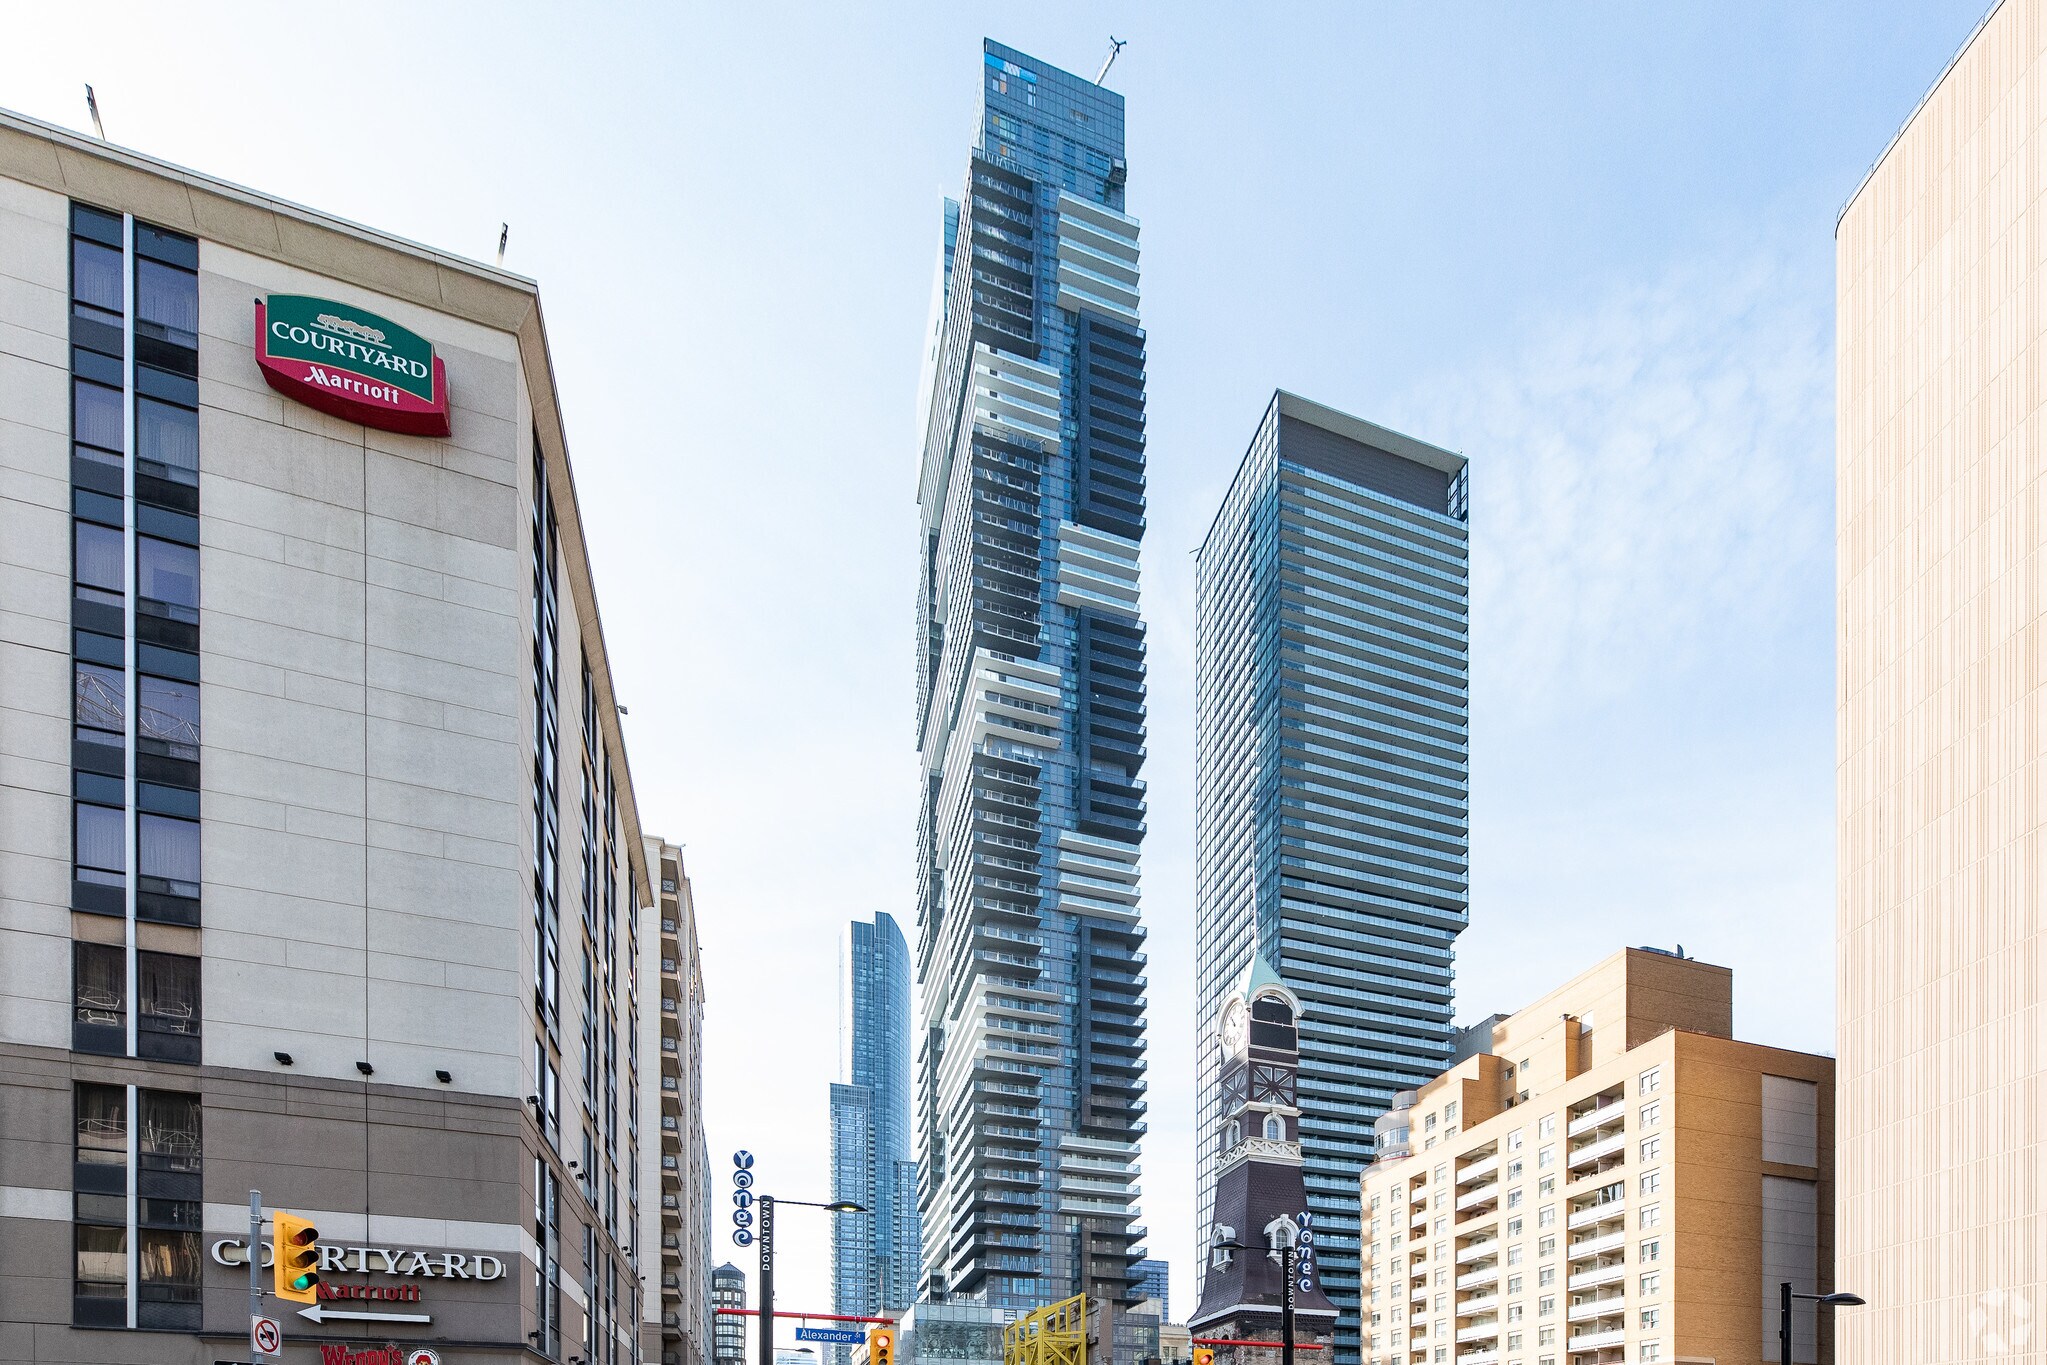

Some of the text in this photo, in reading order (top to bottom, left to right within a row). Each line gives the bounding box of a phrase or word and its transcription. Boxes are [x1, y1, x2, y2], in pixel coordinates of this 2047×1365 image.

[271, 321, 428, 379] COURTYARD
[304, 366, 399, 404] Marriott
[733, 1150, 754, 1247] Yonge
[211, 1239, 503, 1280] CORTYARD
[762, 1200, 770, 1271] DOWNTOWN
[1296, 1211, 1313, 1293] Yonge
[800, 1329, 852, 1341] Alexander
